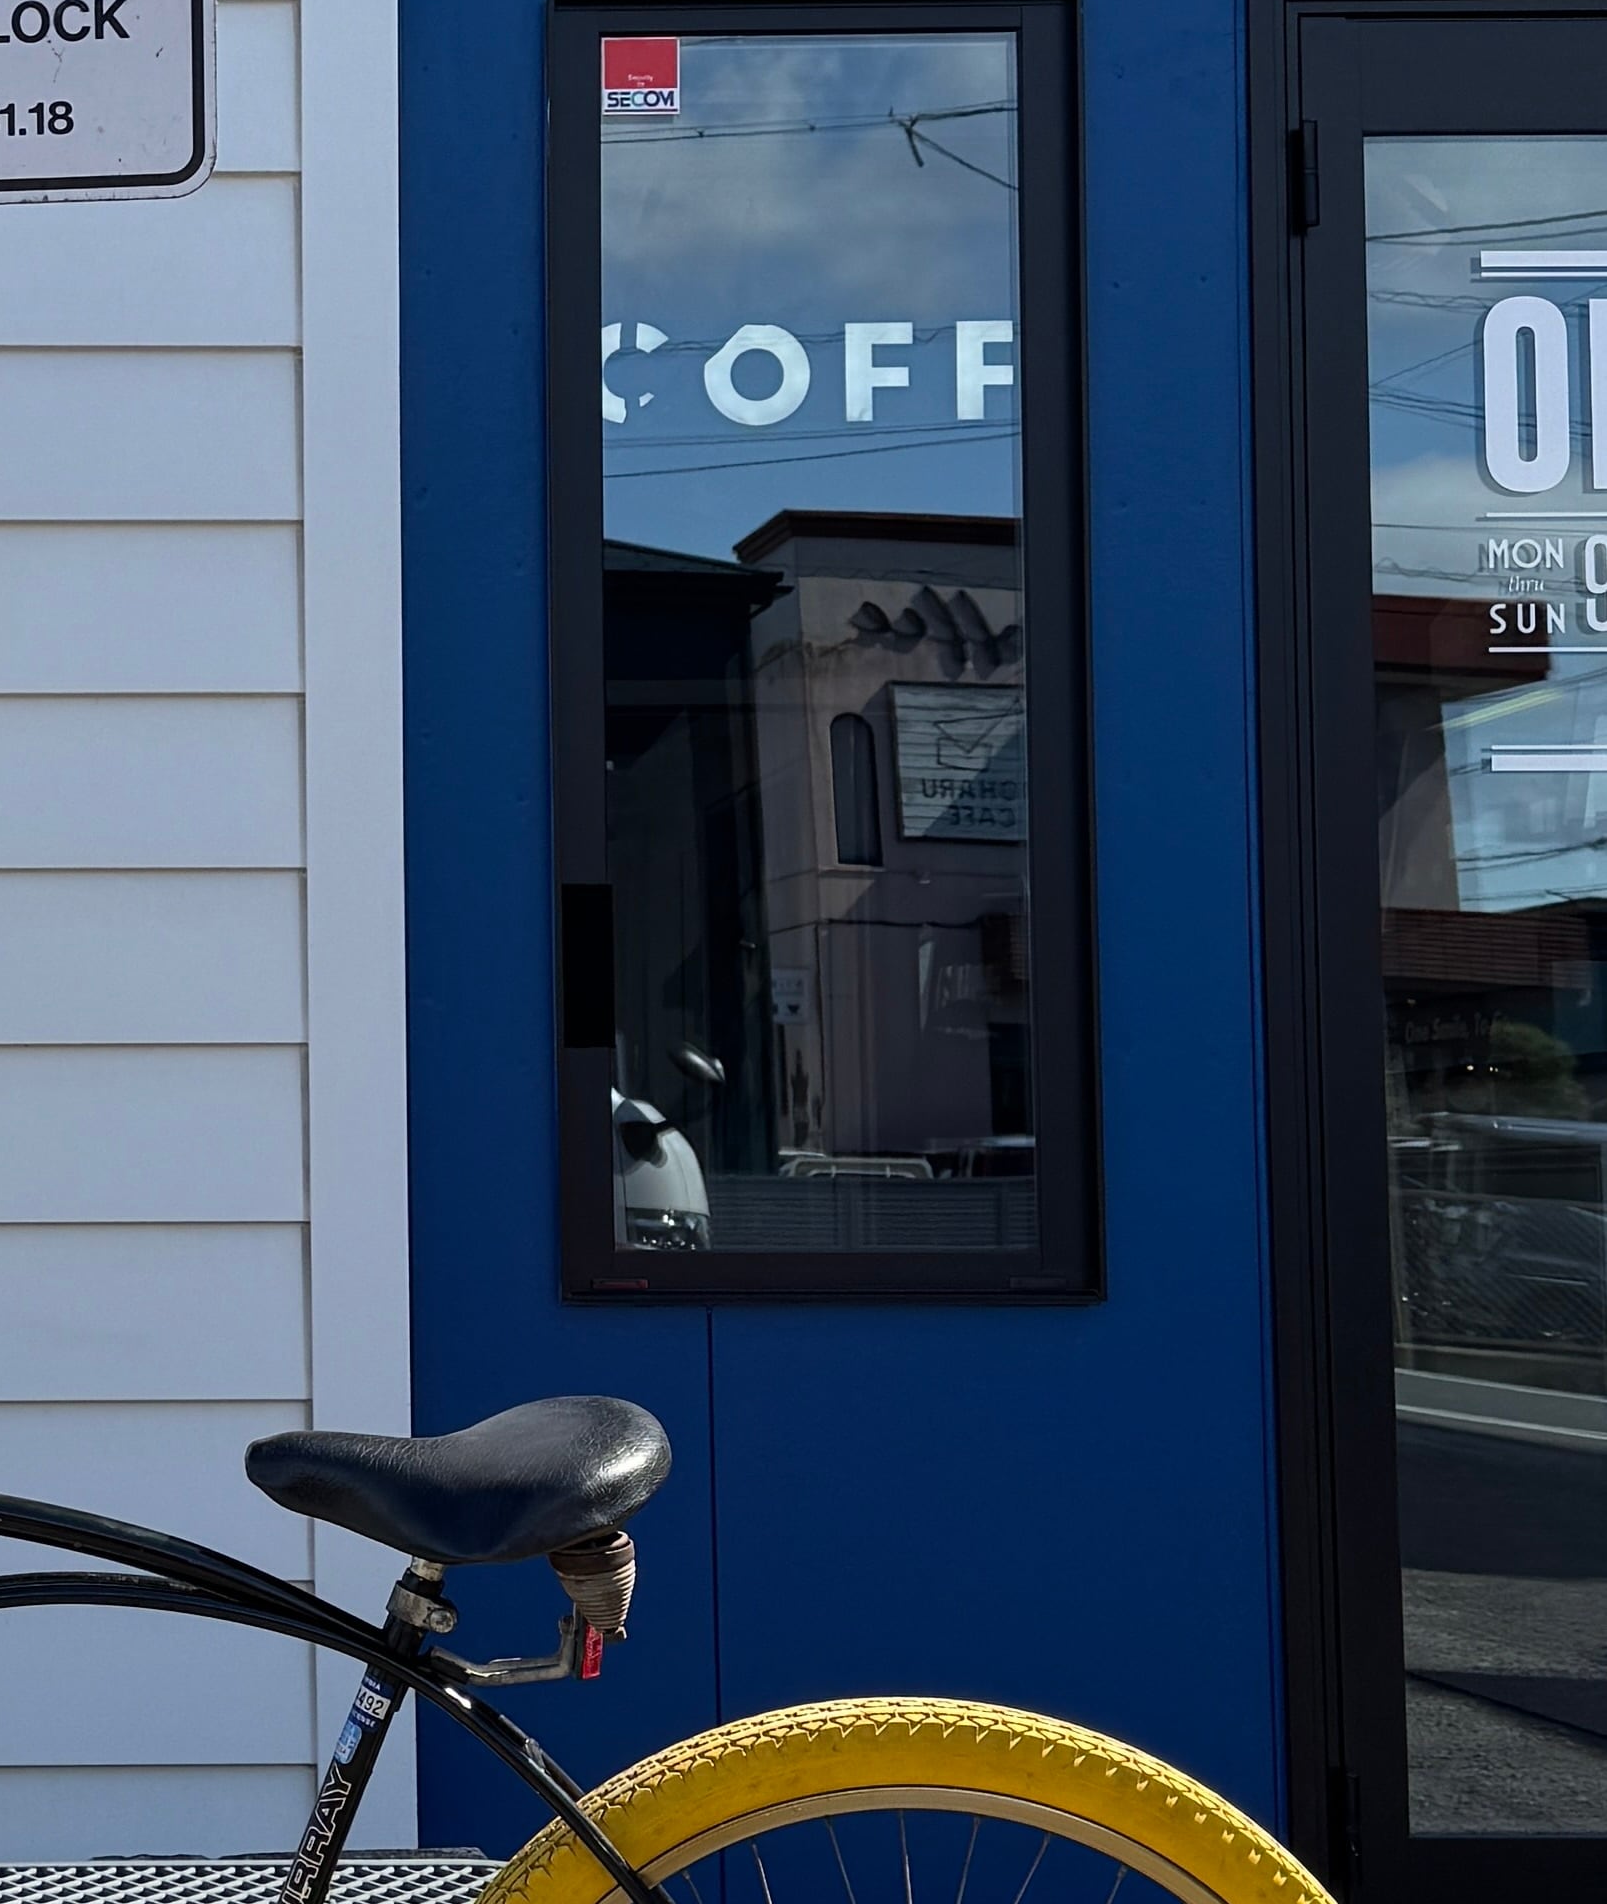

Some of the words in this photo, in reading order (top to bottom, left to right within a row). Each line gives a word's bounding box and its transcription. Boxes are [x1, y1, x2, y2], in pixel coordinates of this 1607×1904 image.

[607, 90, 675, 108] SECOM
[1482, 295, 1607, 494] O
[1488, 538, 1565, 569] MON
[1508, 575, 1545, 593] thru
[1489, 603, 1566, 635] SUN
